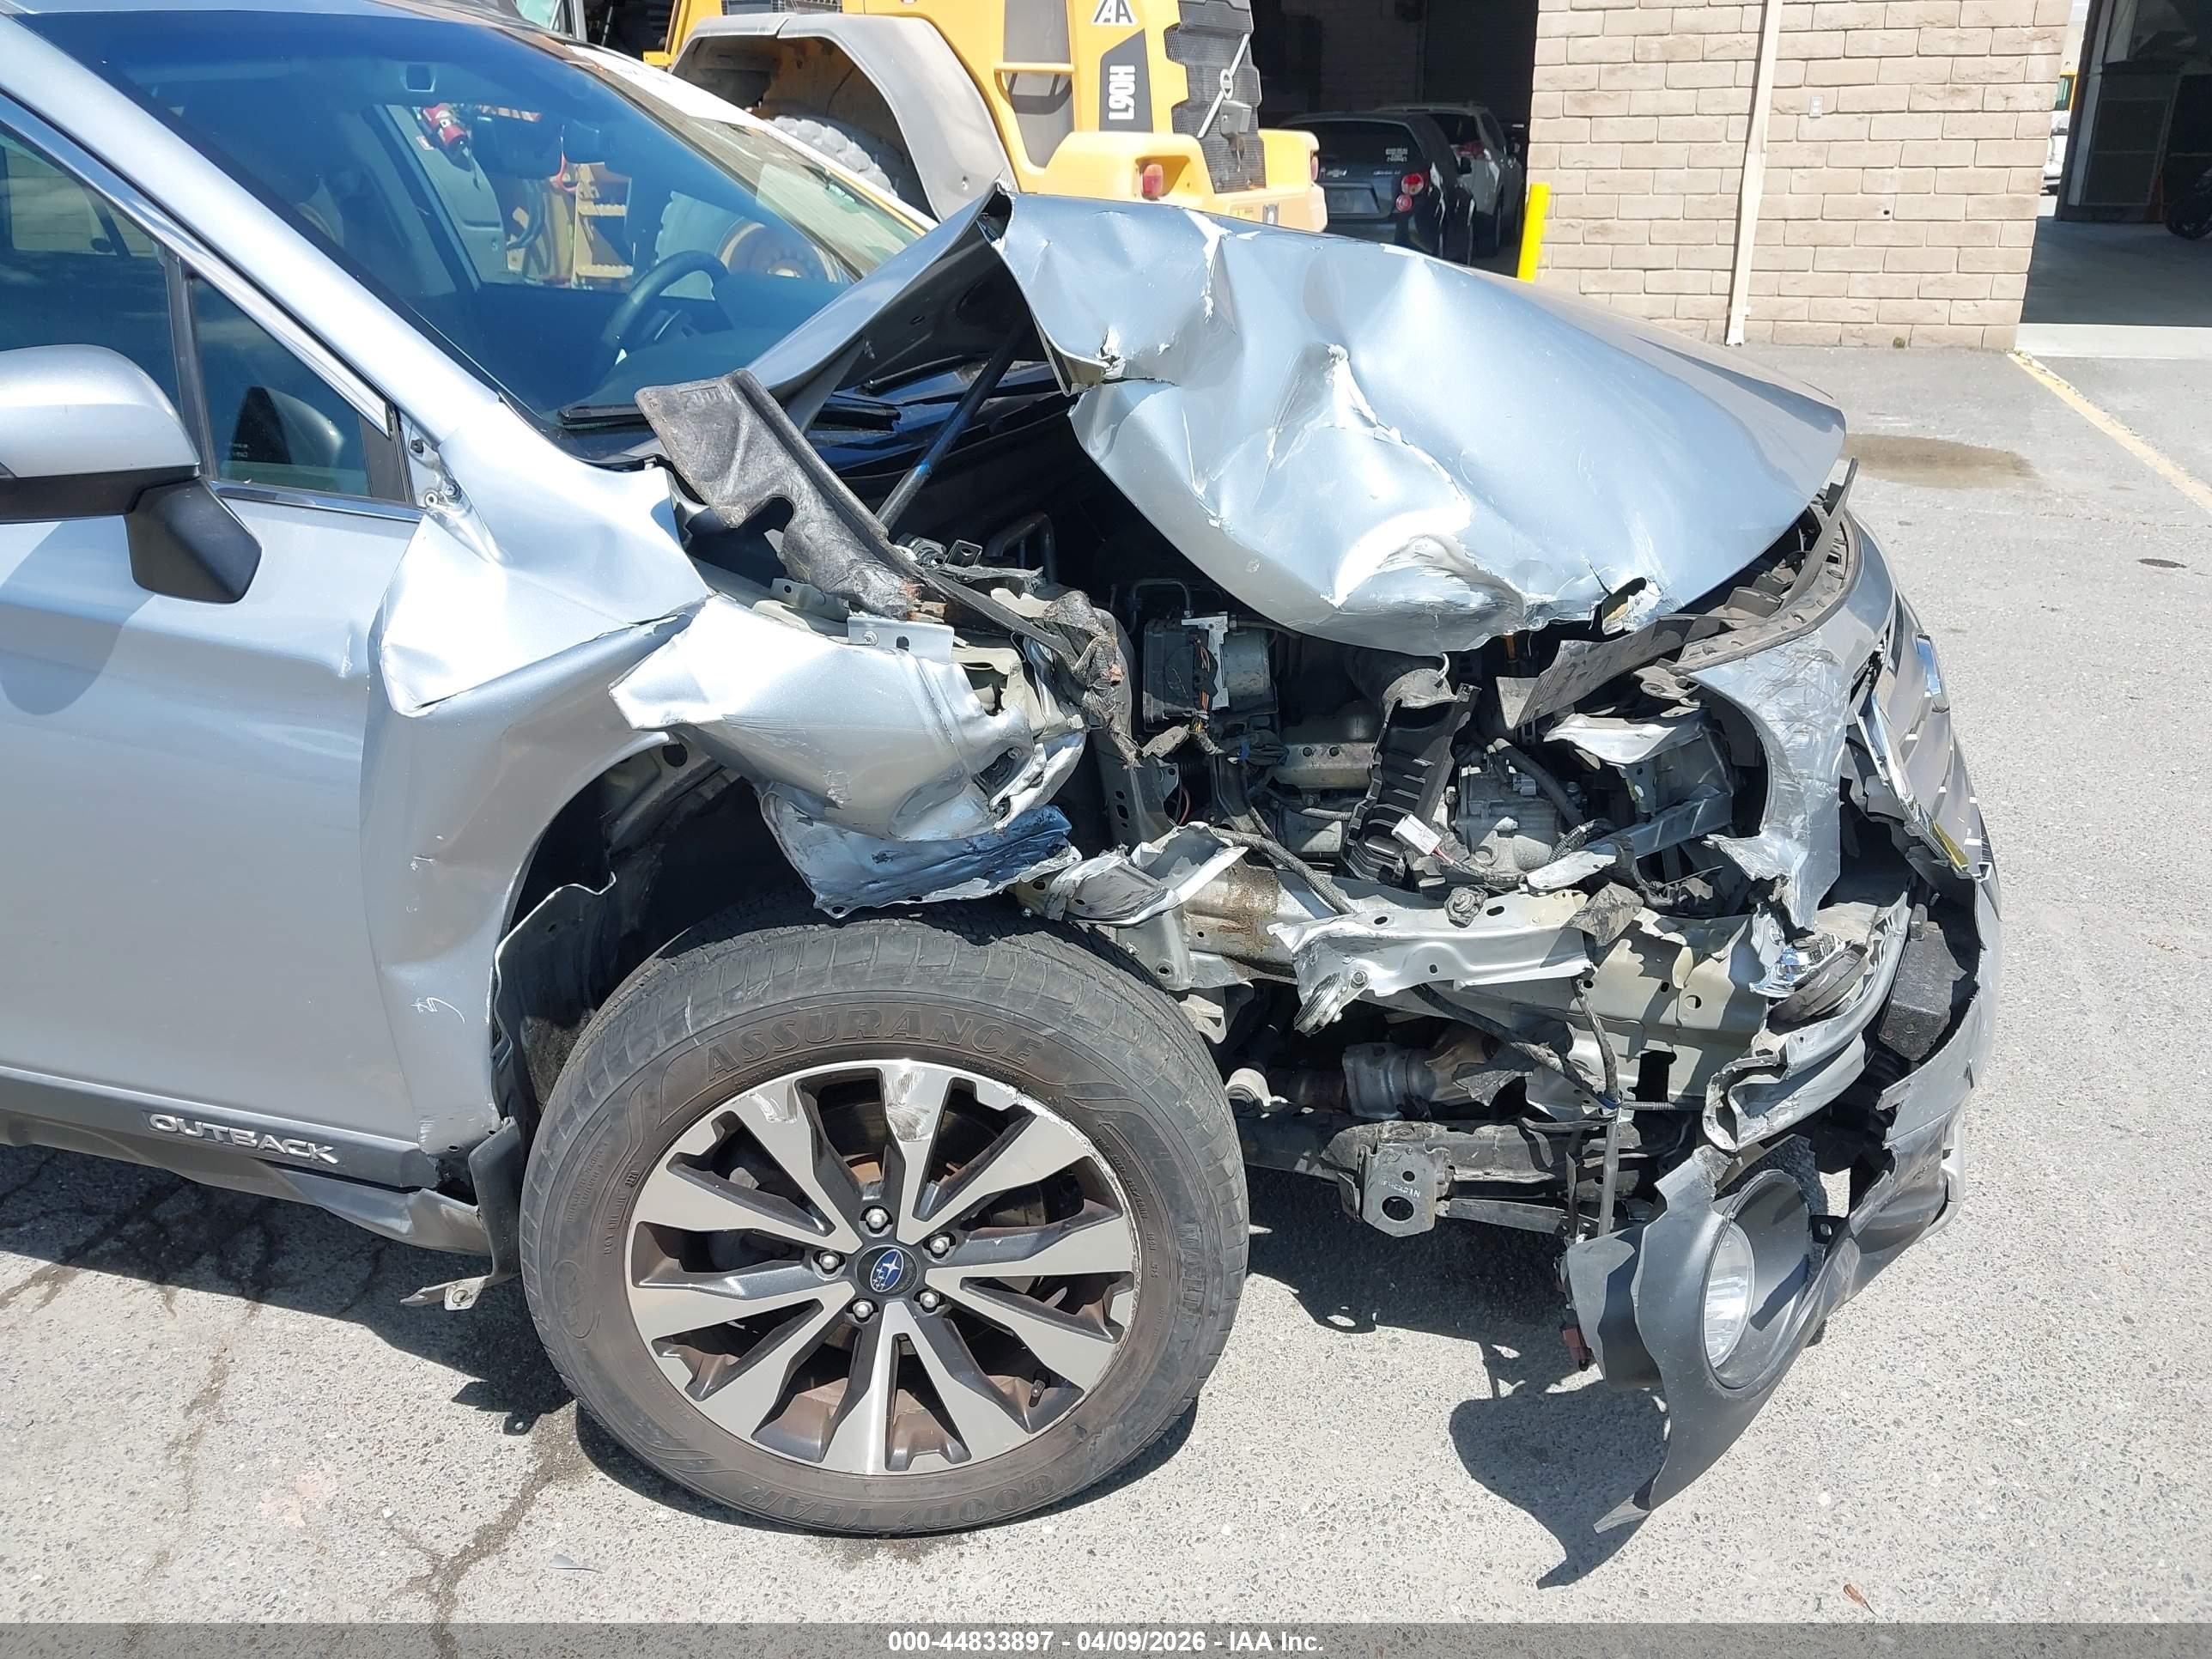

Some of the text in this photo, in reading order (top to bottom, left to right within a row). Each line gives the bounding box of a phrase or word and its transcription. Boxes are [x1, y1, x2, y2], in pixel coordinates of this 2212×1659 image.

[1108, 64, 1135, 120] L90H
[706, 1007, 1045, 1081] ASSURANCE
[149, 1114, 340, 1164] OUTBACK
